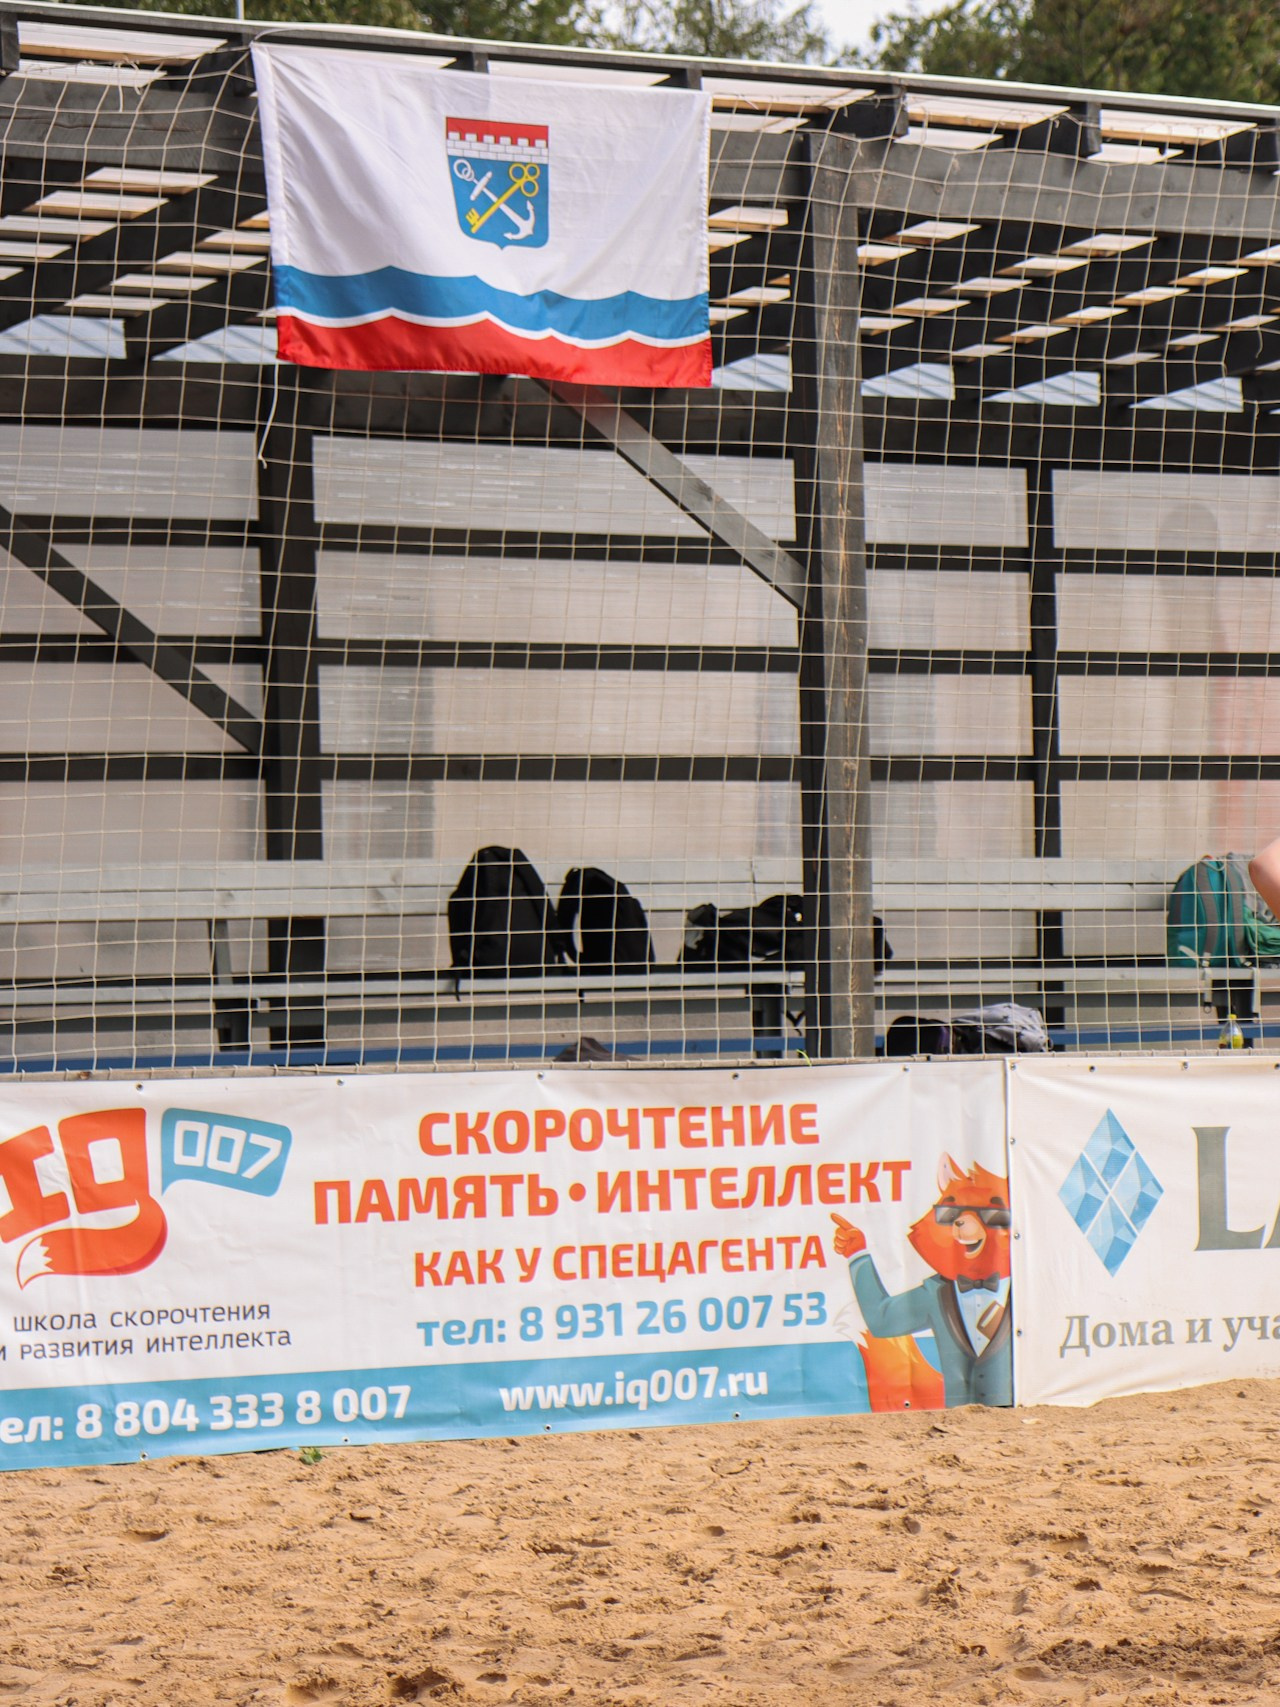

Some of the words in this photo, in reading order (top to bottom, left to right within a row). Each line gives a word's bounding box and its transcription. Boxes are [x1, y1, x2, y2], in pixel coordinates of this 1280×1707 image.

[173, 1120, 283, 1179] 007
[418, 1103, 820, 1156] СКОРОЧТЕНИЕ
[314, 1173, 559, 1225] ПАМЯТЬ
[597, 1161, 912, 1213] ИНТЕЛЛЕКТ
[415, 1249, 505, 1287] КАК
[515, 1247, 542, 1283] У
[553, 1235, 827, 1283] СПЕЦАГЕНТА
[14, 1312, 96, 1332] школа
[110, 1304, 271, 1329] скорочтения
[417, 1318, 506, 1346] тел:
[520, 1306, 544, 1341] 8
[556, 1303, 623, 1340] 931
[637, 1299, 687, 1335] 26
[699, 1295, 773, 1332] 007
[783, 1291, 827, 1327] 53
[1059, 1314, 1175, 1358] Дома
[1186, 1317, 1212, 1343] и
[20, 1338, 133, 1361] развития
[147, 1330, 292, 1353] интеллекта
[0, 1415, 63, 1444] ел:
[76, 1403, 103, 1438] 8
[114, 1398, 200, 1437] 804
[210, 1391, 285, 1430] 333
[296, 1389, 322, 1425] 8
[333, 1385, 412, 1422] 007
[499, 1366, 769, 1411] www.iq007.ru
